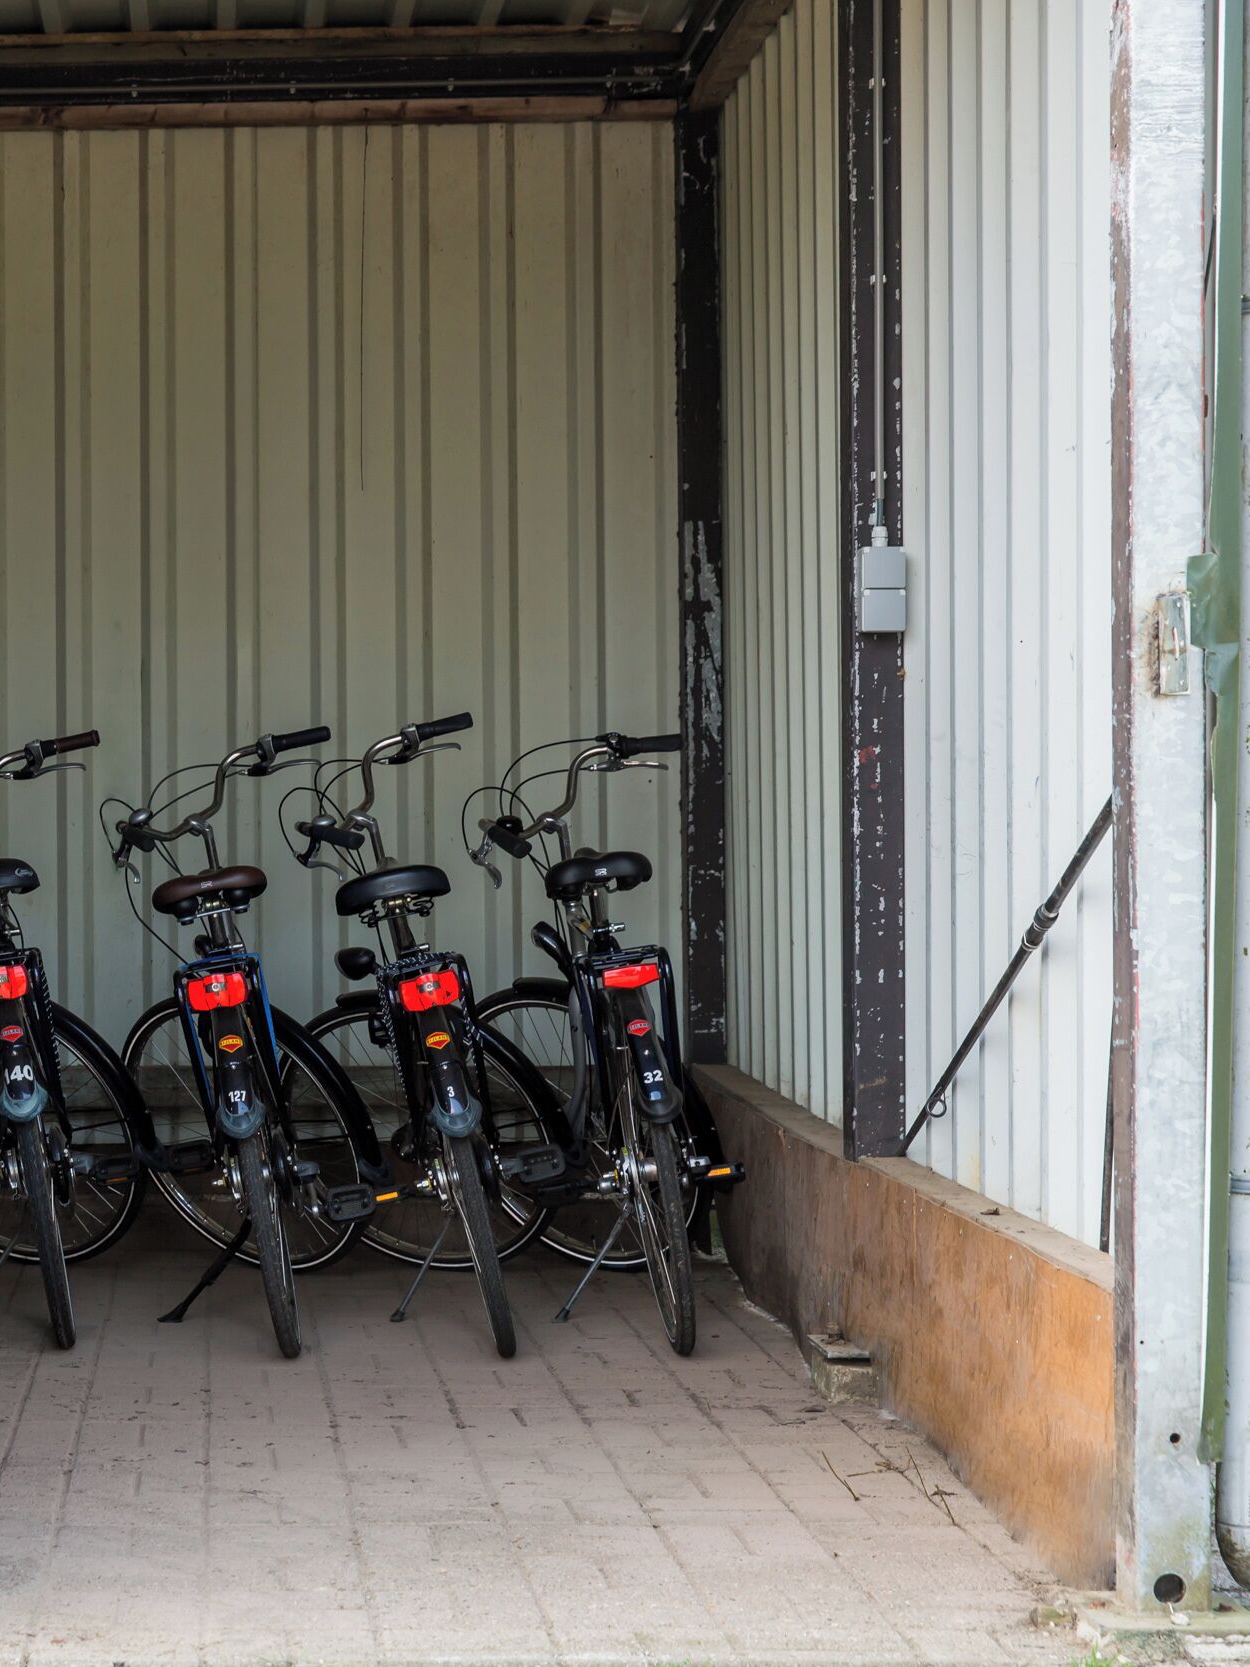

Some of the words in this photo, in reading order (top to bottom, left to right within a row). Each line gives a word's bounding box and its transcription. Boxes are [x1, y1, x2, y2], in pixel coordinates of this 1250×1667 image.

[4, 1064, 34, 1085] 140
[643, 1069, 664, 1084] 32
[228, 1089, 247, 1103] 127
[446, 1085, 455, 1098] 3
